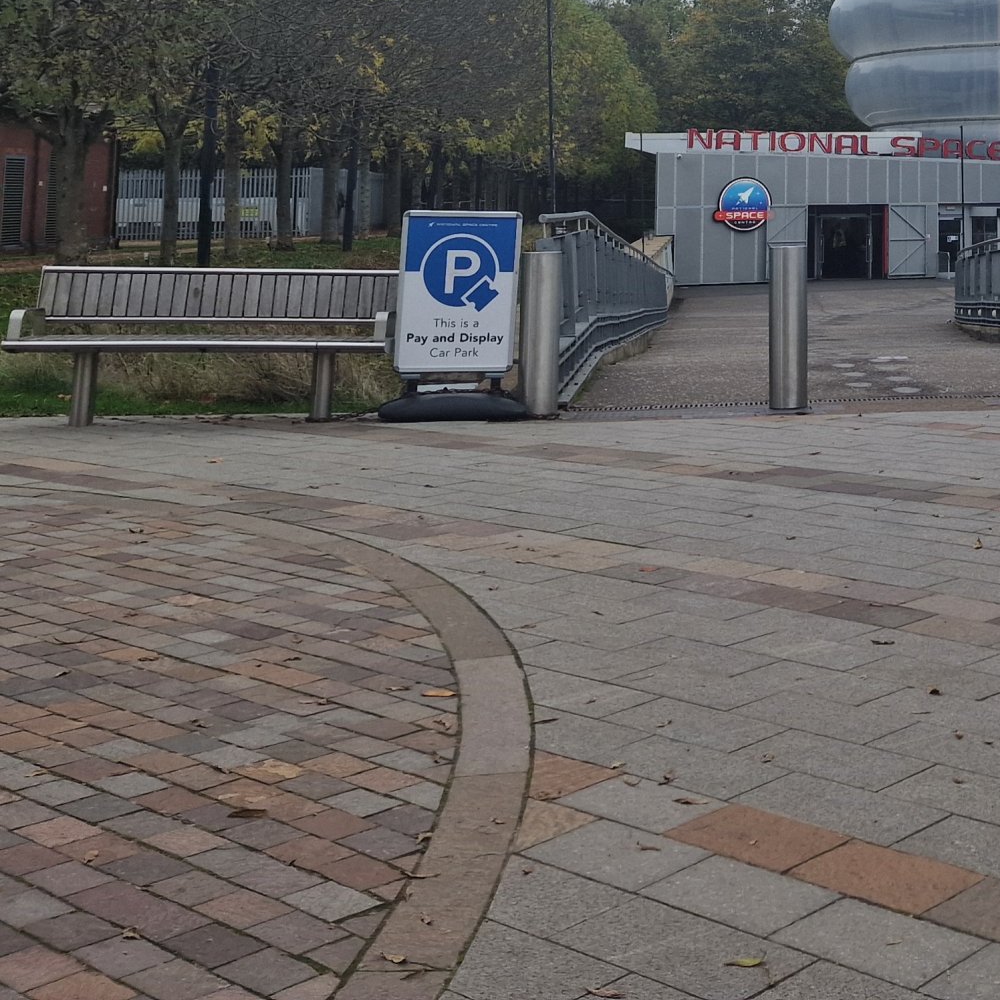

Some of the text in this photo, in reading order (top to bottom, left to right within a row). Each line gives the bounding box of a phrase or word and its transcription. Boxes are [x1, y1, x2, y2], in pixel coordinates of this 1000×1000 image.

[687, 128, 878, 155] NATIONAL
[725, 211, 765, 220] SPACE
[444, 249, 481, 294] P
[433, 318, 479, 328] This is a
[406, 332, 504, 346] Pay and Display
[429, 347, 479, 358] Car Park
